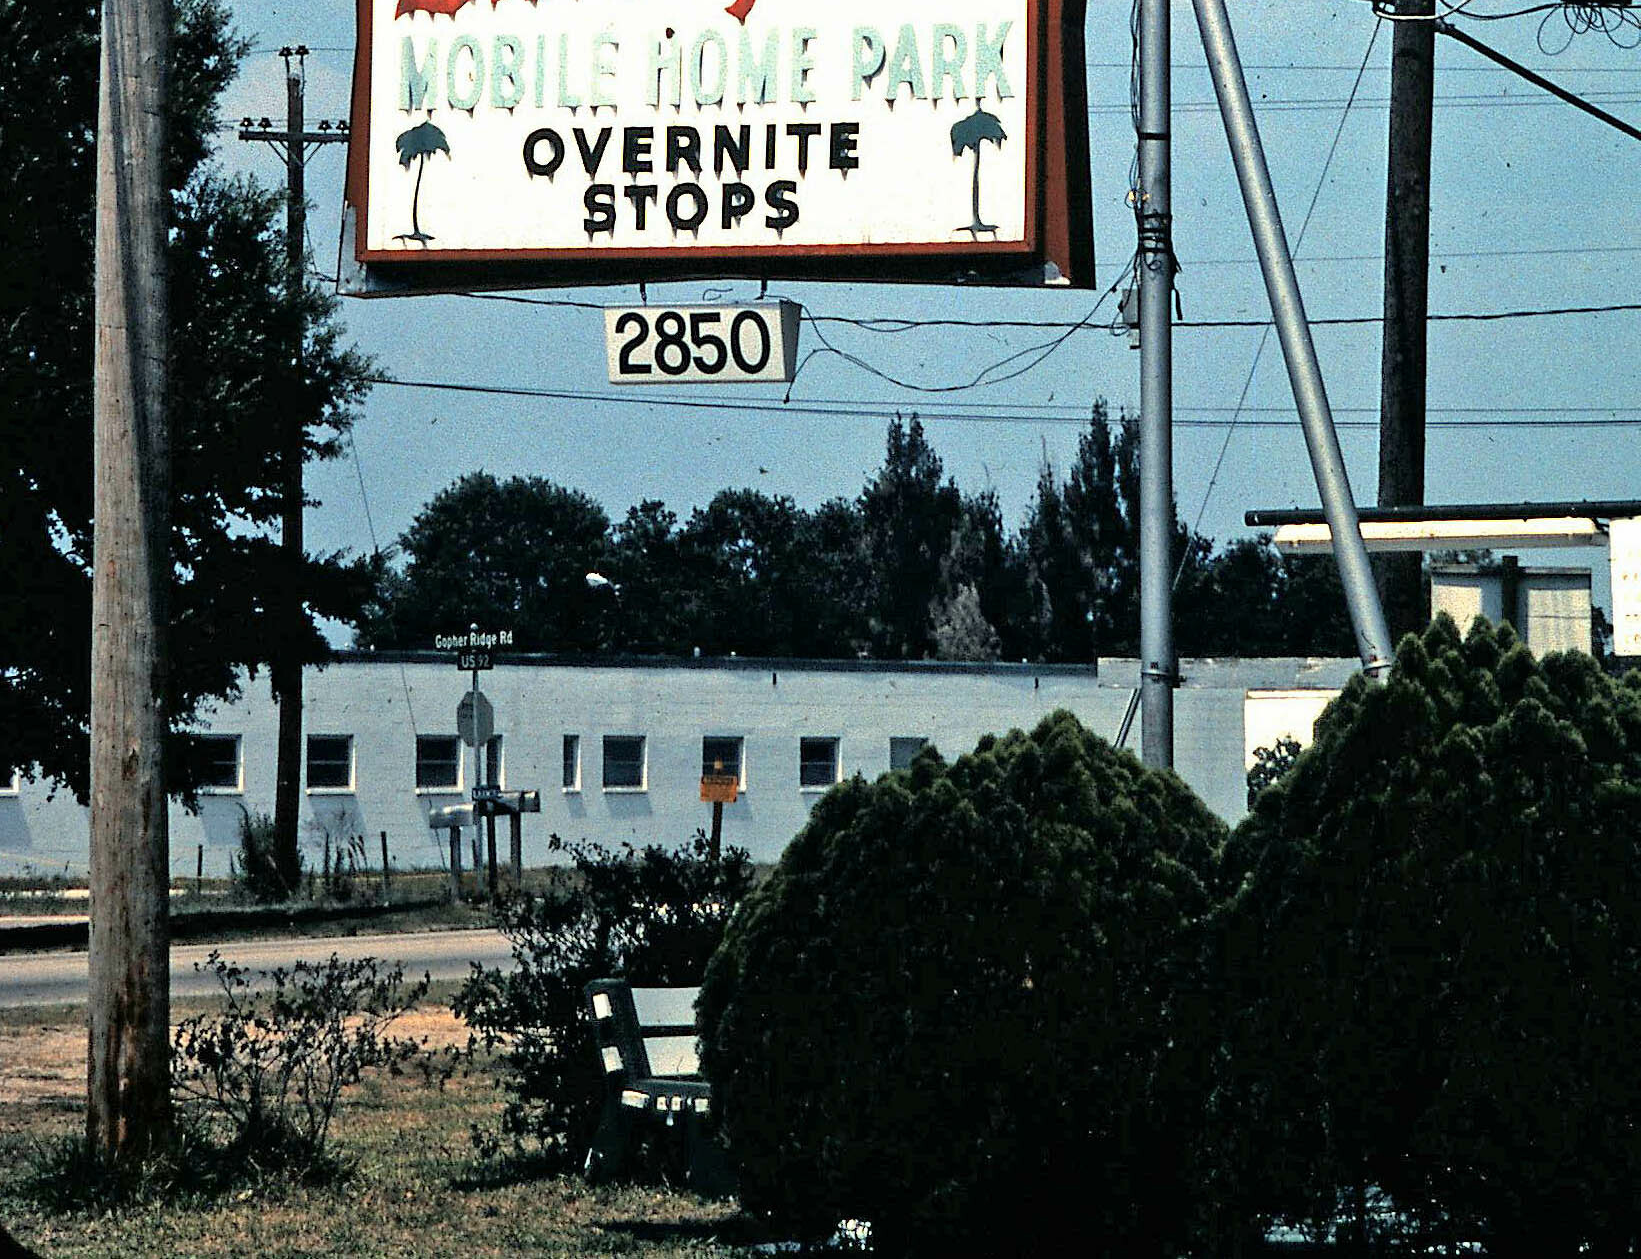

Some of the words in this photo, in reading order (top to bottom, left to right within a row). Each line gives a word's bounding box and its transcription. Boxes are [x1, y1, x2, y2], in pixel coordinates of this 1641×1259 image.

[398, 32, 618, 114] MOBILE
[648, 27, 818, 109] HOME
[851, 21, 1015, 104] PARK
[523, 122, 860, 177] OVERNITE
[584, 179, 800, 232] STOPS
[615, 310, 771, 375] 2850
[435, 634, 468, 650] Gopher
[470, 631, 497, 649] Ridge
[500, 630, 513, 645] Rd
[461, 654, 476, 668] US
